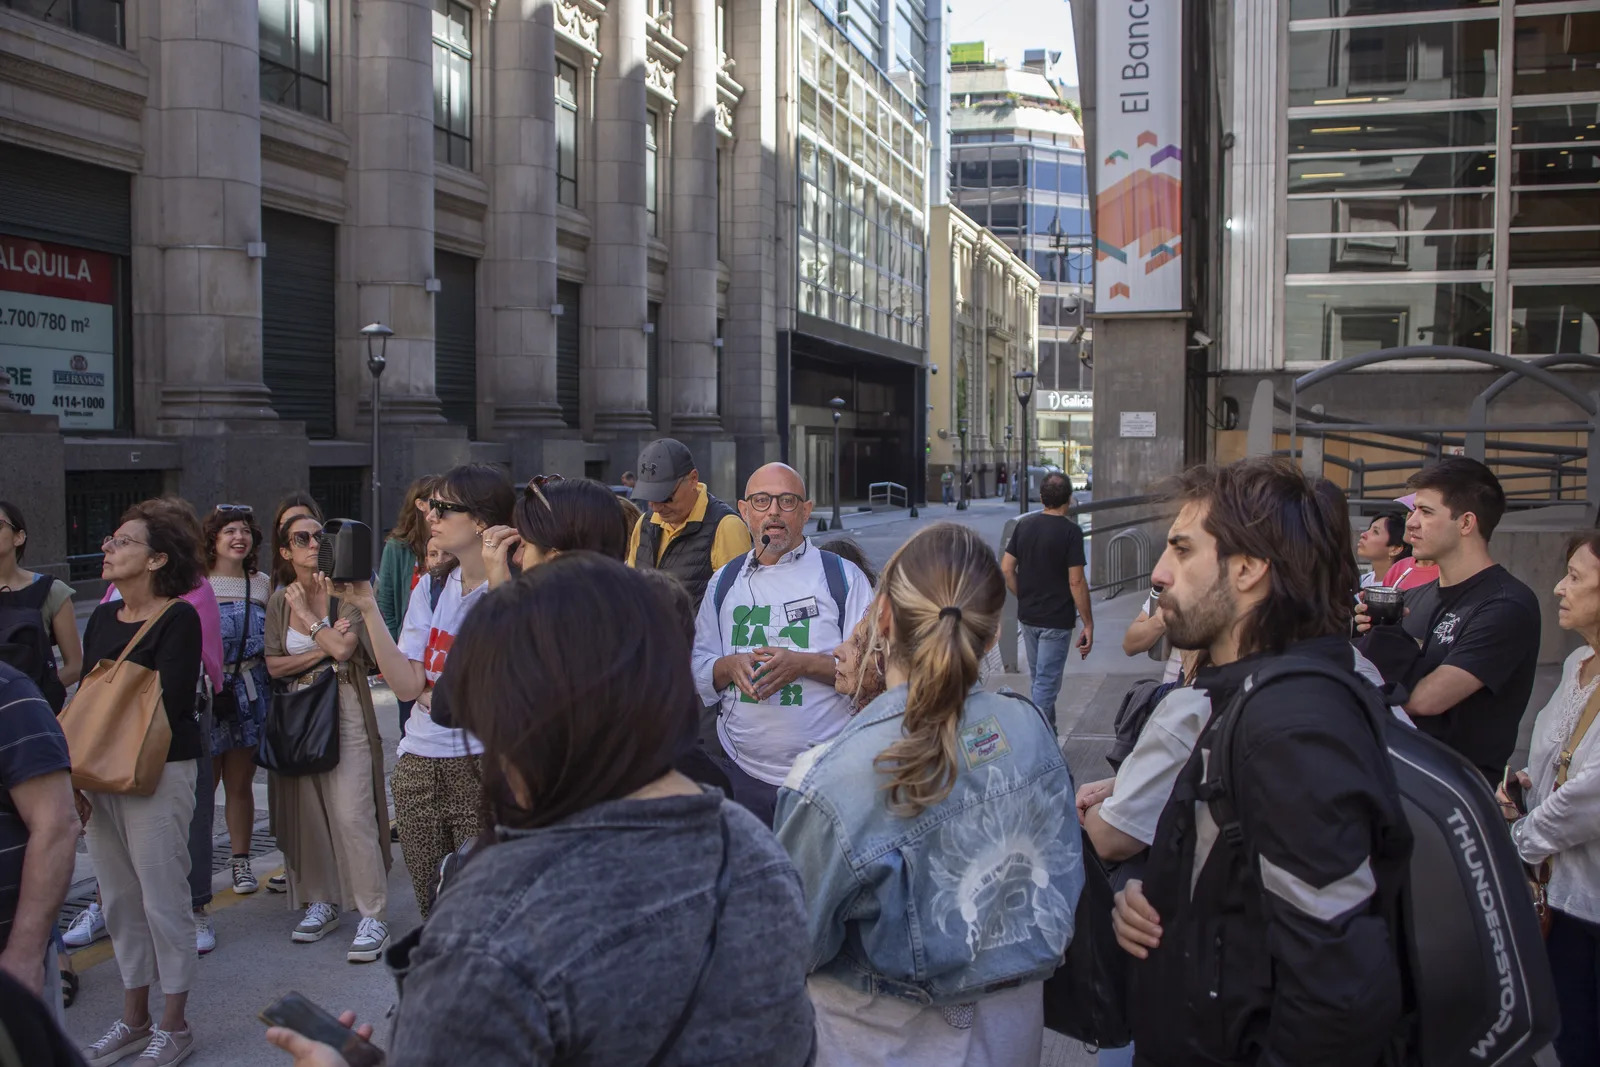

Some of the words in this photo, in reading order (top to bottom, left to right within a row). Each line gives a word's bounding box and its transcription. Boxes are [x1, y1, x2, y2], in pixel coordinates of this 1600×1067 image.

[1122, 0, 1149, 80] Banc
[1120, 91, 1149, 113] El
[0, 307, 66, 331] .700/780
[0, 366, 32, 385] RE
[52, 395, 105, 409] 4114-1000
[1061, 394, 1093, 408] Galicia
[1446, 807, 1516, 1060] THUNDERSTORM
